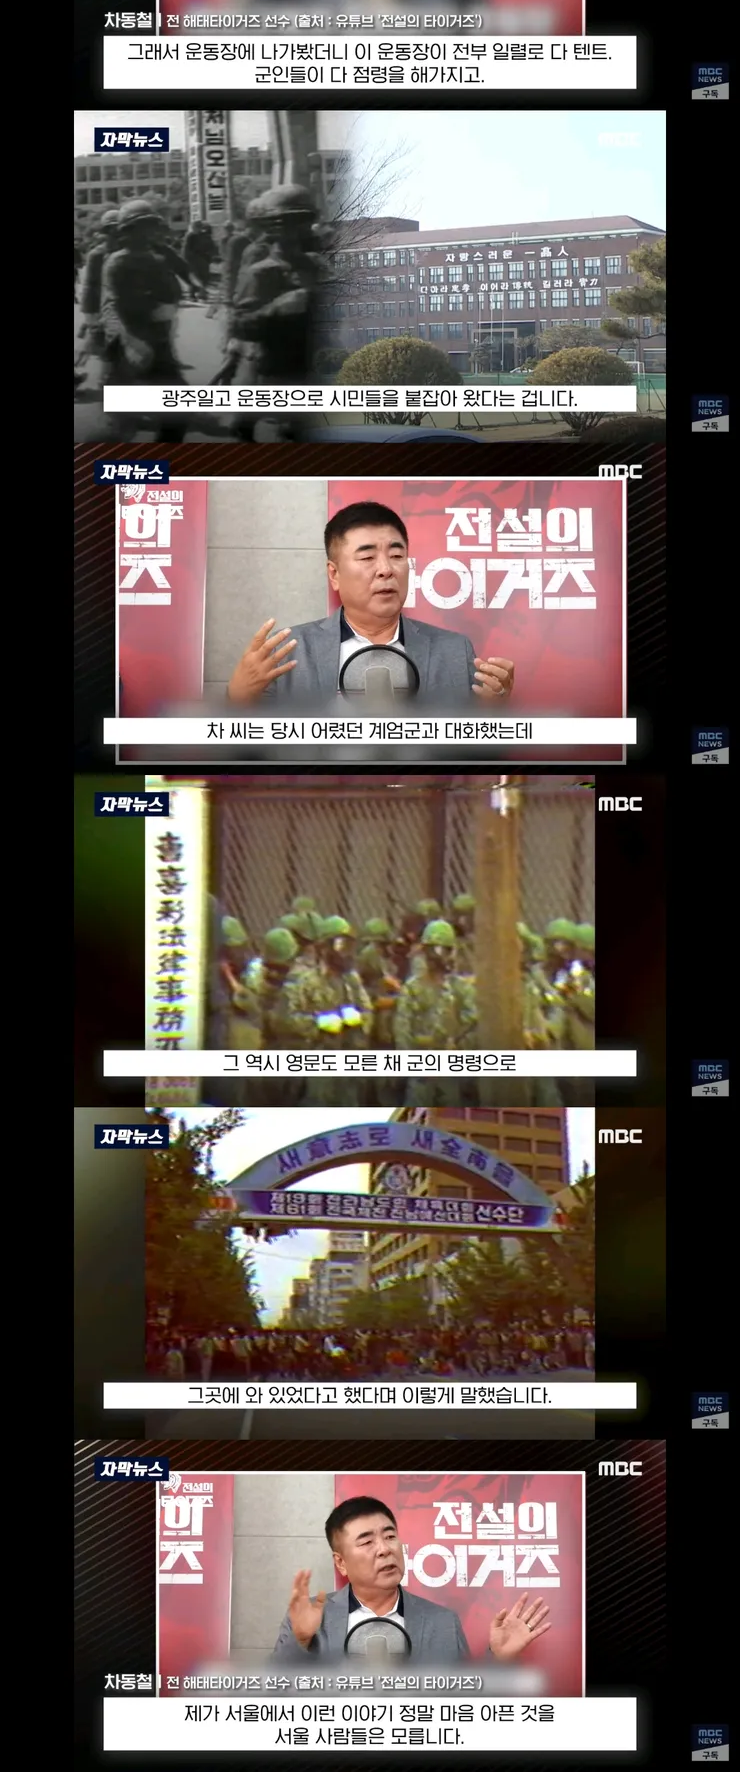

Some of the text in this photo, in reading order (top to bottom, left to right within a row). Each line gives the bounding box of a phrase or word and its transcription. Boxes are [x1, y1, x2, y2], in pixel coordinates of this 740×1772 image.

[445, 249, 513, 263] 자랑스러운
[445, 508, 593, 552] 전설의
[433, 1502, 558, 1540] 전설의
